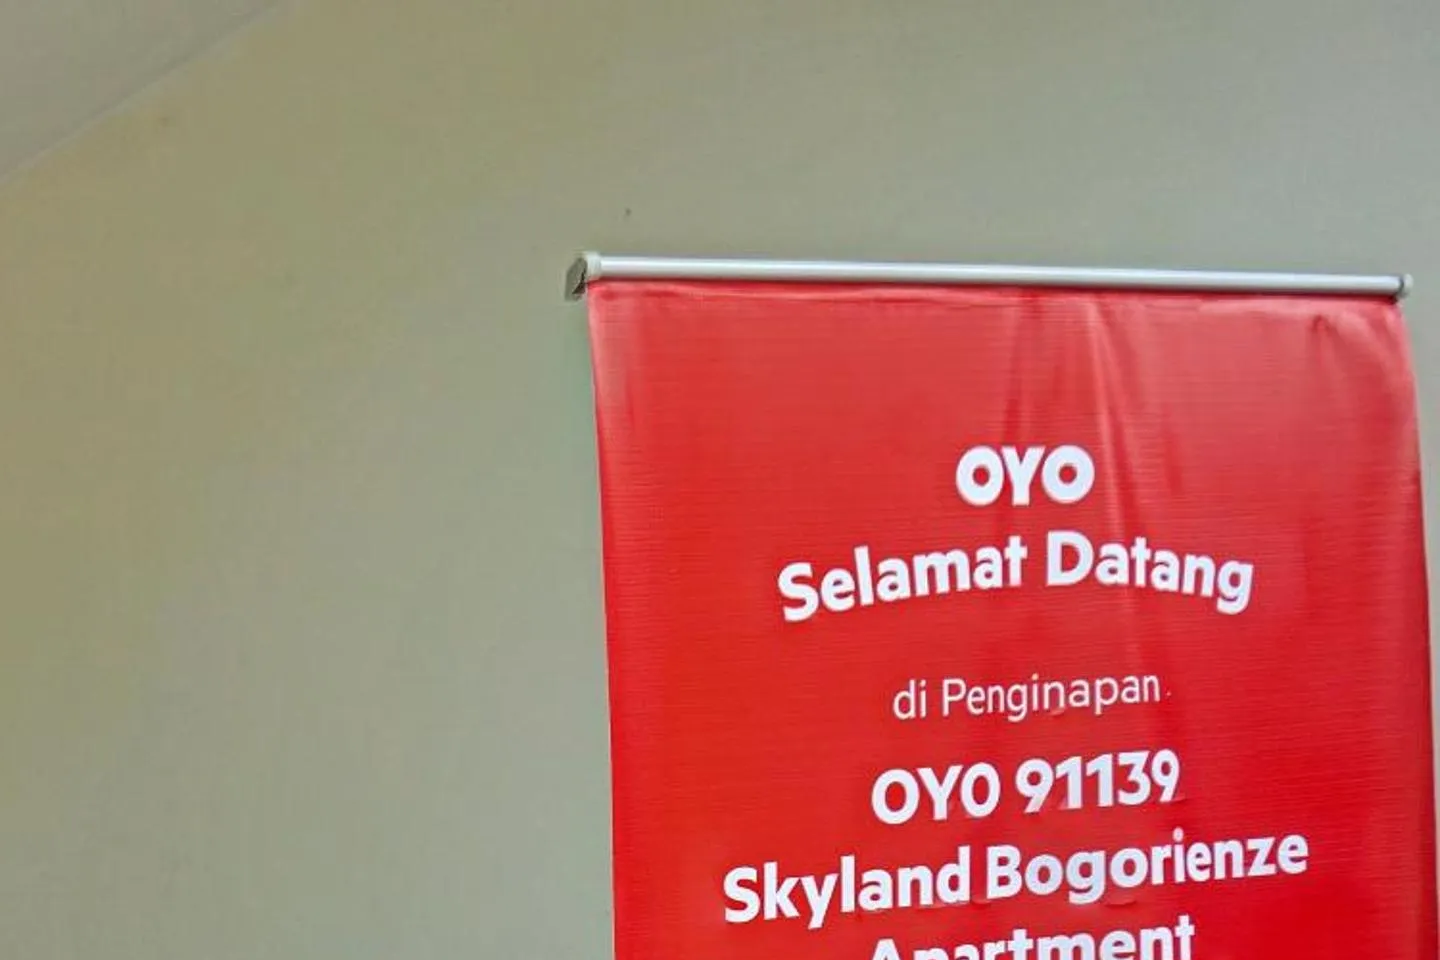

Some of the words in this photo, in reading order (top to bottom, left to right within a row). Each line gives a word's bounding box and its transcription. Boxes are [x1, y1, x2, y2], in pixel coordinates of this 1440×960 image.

[956, 445, 1095, 506] OYO
[777, 535, 1028, 621] Selamat
[1046, 530, 1254, 615] Datang
[893, 680, 927, 720] di
[941, 672, 1161, 722] Penginapan
[1015, 749, 1180, 813] 91139
[723, 846, 971, 929] Skyland
[985, 827, 1310, 906] Bogorienze
